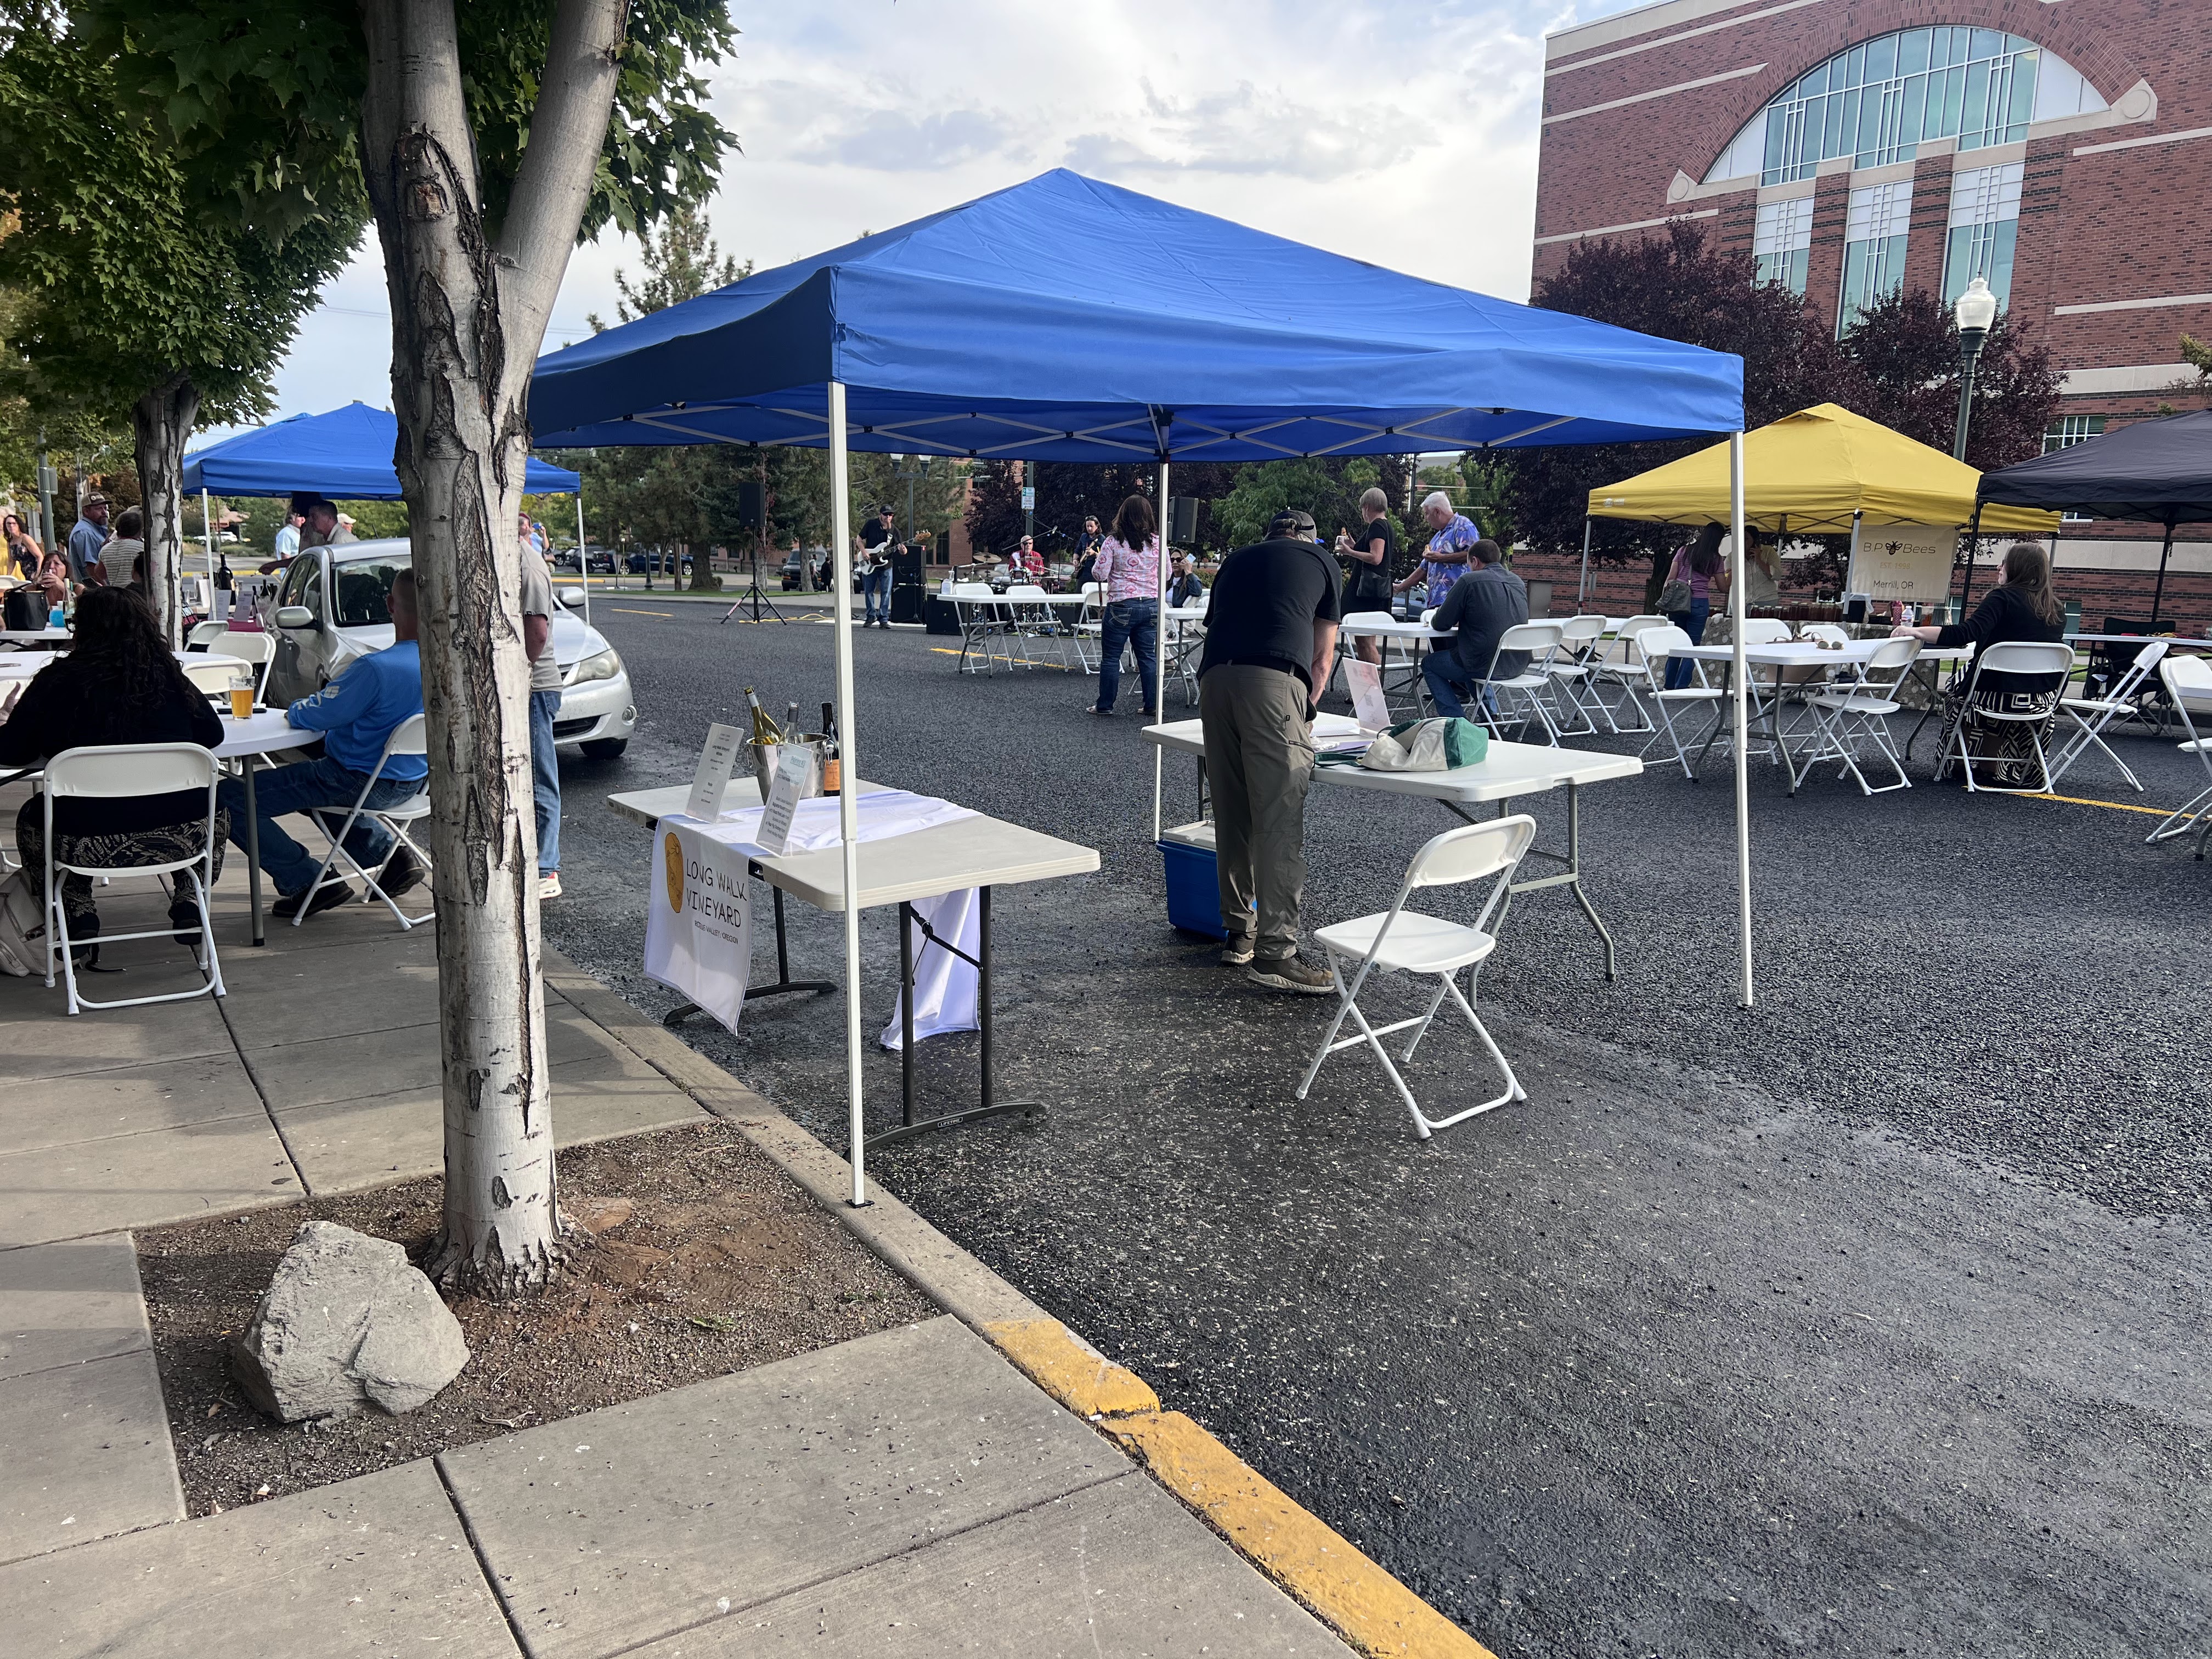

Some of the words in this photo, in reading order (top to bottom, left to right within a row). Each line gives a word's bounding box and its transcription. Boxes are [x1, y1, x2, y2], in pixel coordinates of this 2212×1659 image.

[1863, 542, 1883, 552] B.P.
[1903, 544, 1936, 554] Bees
[1874, 580, 1899, 590] Merrill,
[1901, 581, 1914, 589] OR
[687, 858, 714, 887] LONG
[716, 871, 747, 901] WALK
[686, 887, 741, 928] VINEYARD
